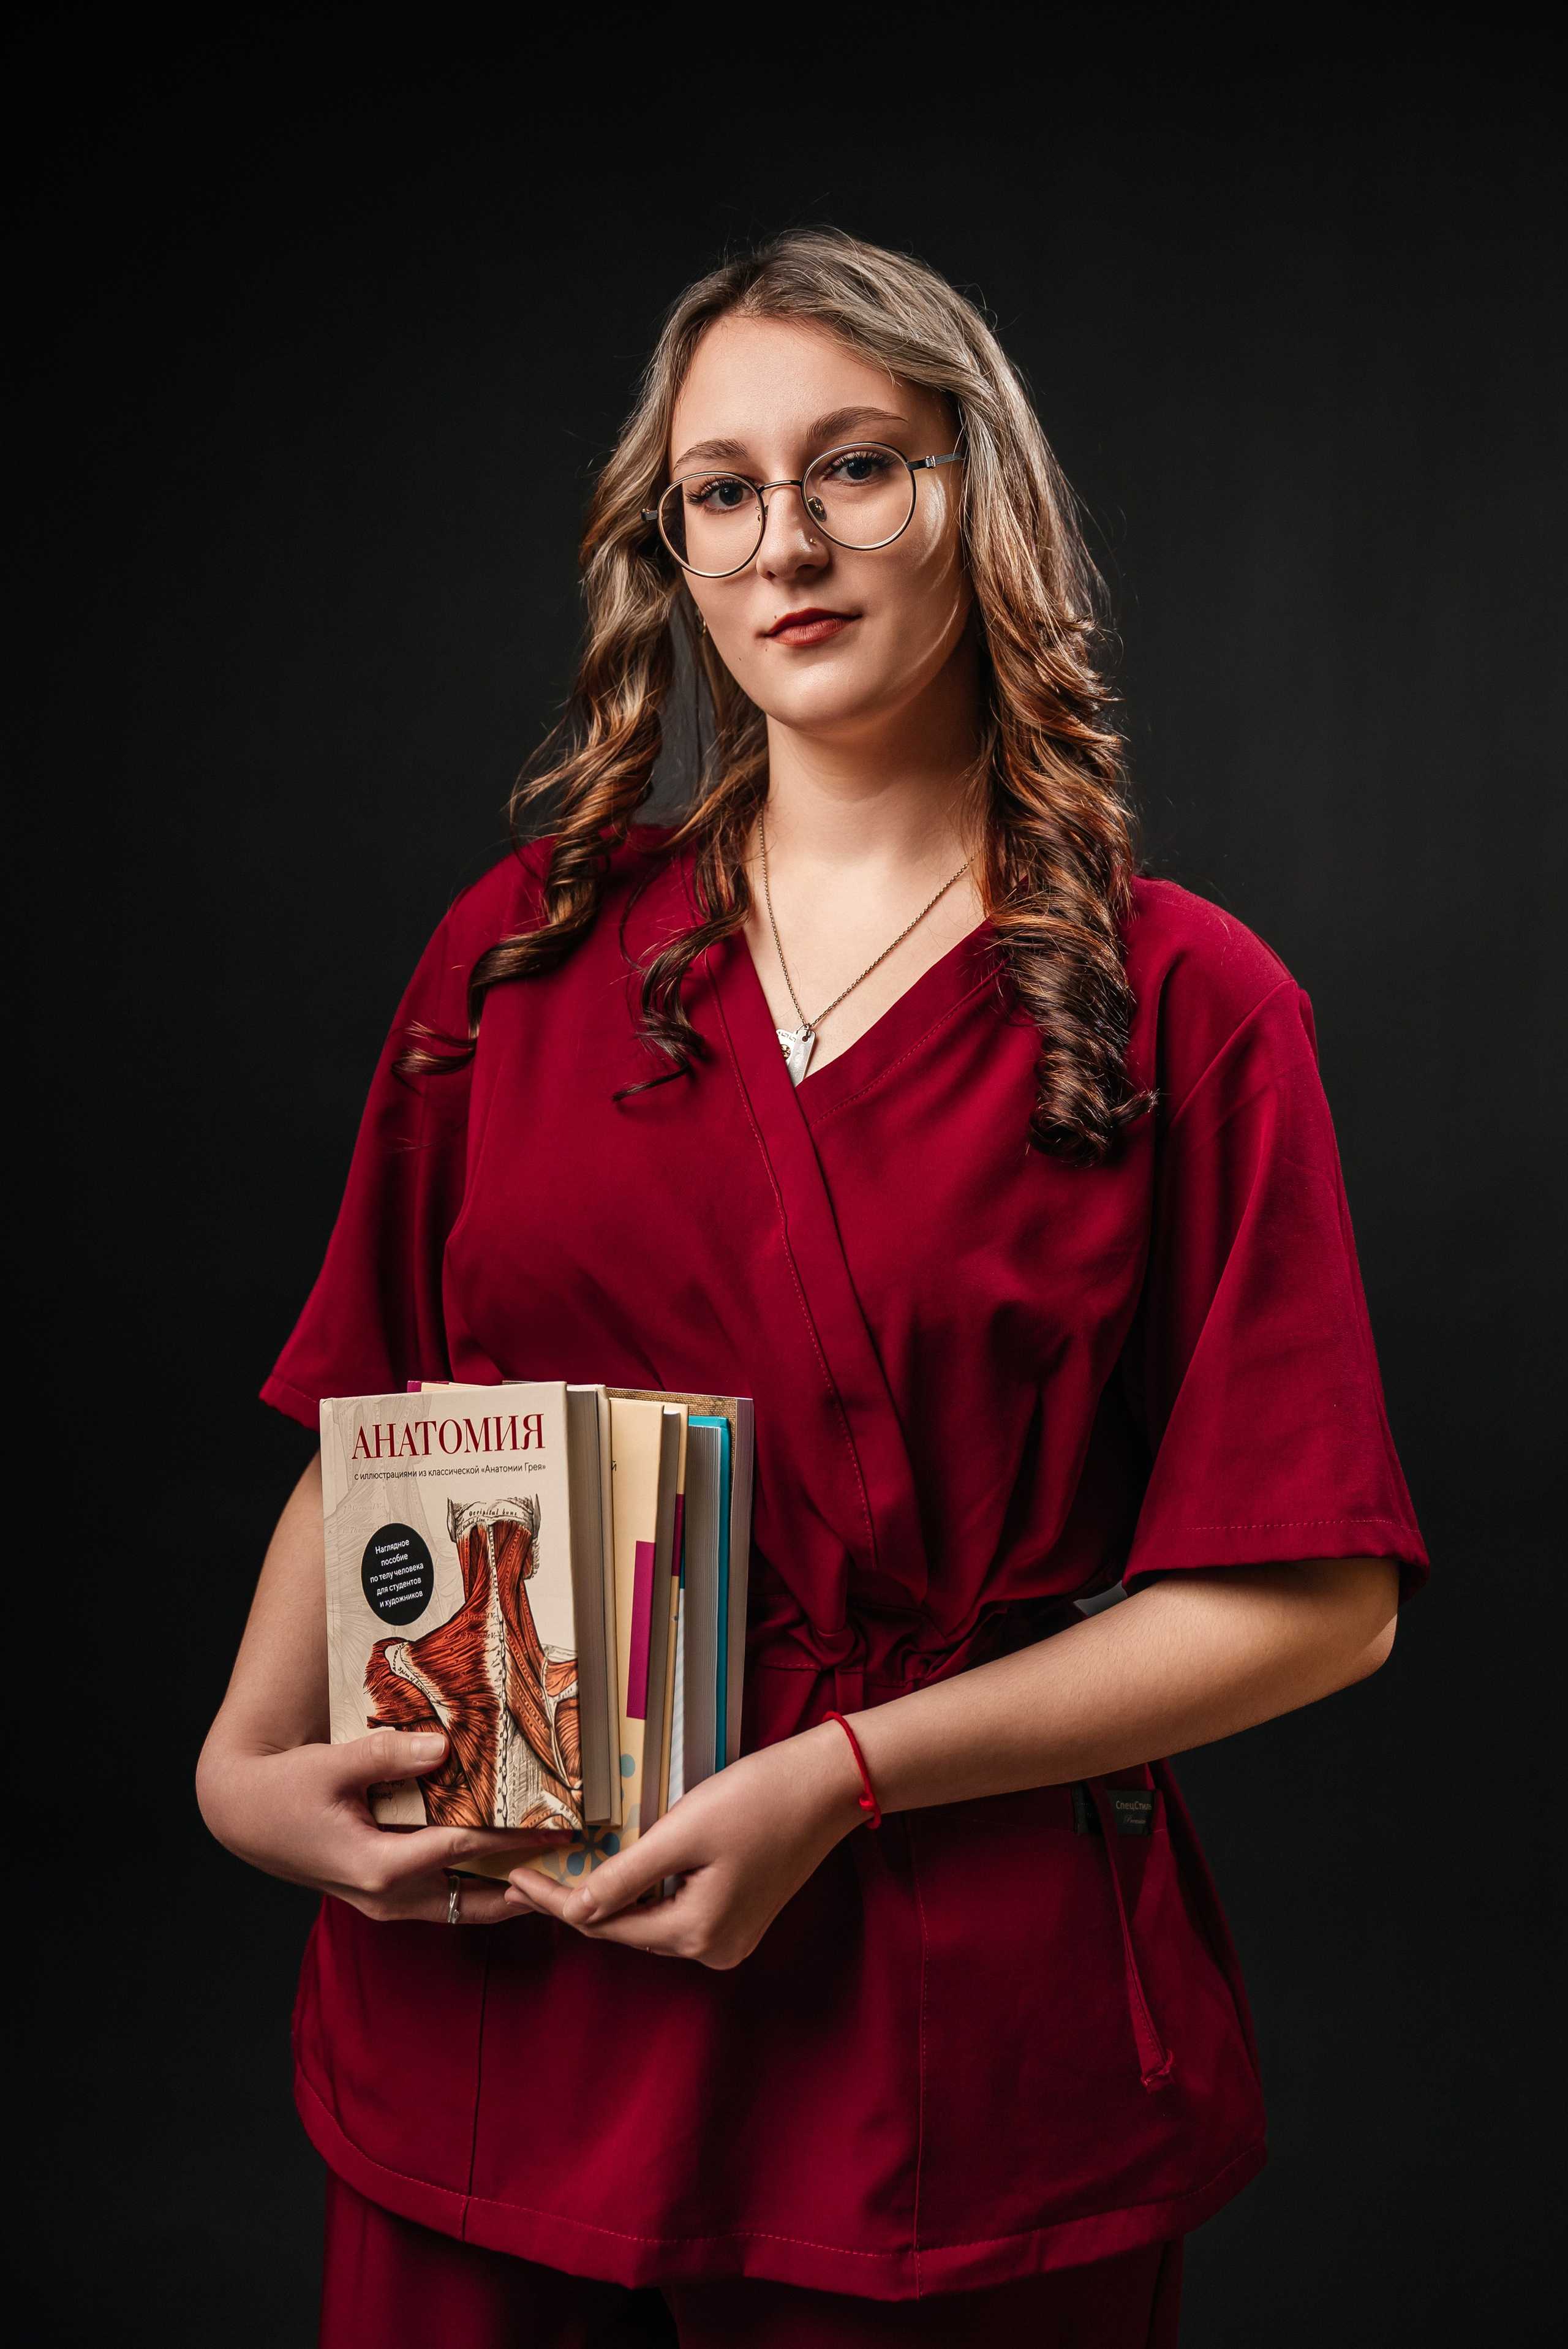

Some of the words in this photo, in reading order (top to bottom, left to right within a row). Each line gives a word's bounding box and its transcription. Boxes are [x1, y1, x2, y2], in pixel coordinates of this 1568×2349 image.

[352, 1414, 545, 1459] АНАТОМИЯ
[360, 1470, 417, 1480] иллюстрациями
[428, 1465, 480, 1476] классической
[481, 1465, 522, 1473] «Анатомии
[524, 1462, 546, 1473] Грея»
[375, 1539, 410, 1555] Наглядное
[381, 1553, 409, 1566] пособие
[379, 1571, 393, 1580] телу
[394, 1563, 424, 1576] человека
[377, 1586, 388, 1596] для
[389, 1577, 421, 1591] студентов
[385, 1591, 423, 1607] художников
[398, 1666, 410, 1678] Spine
[1115, 1800, 1152, 1812] СпецСтиль
